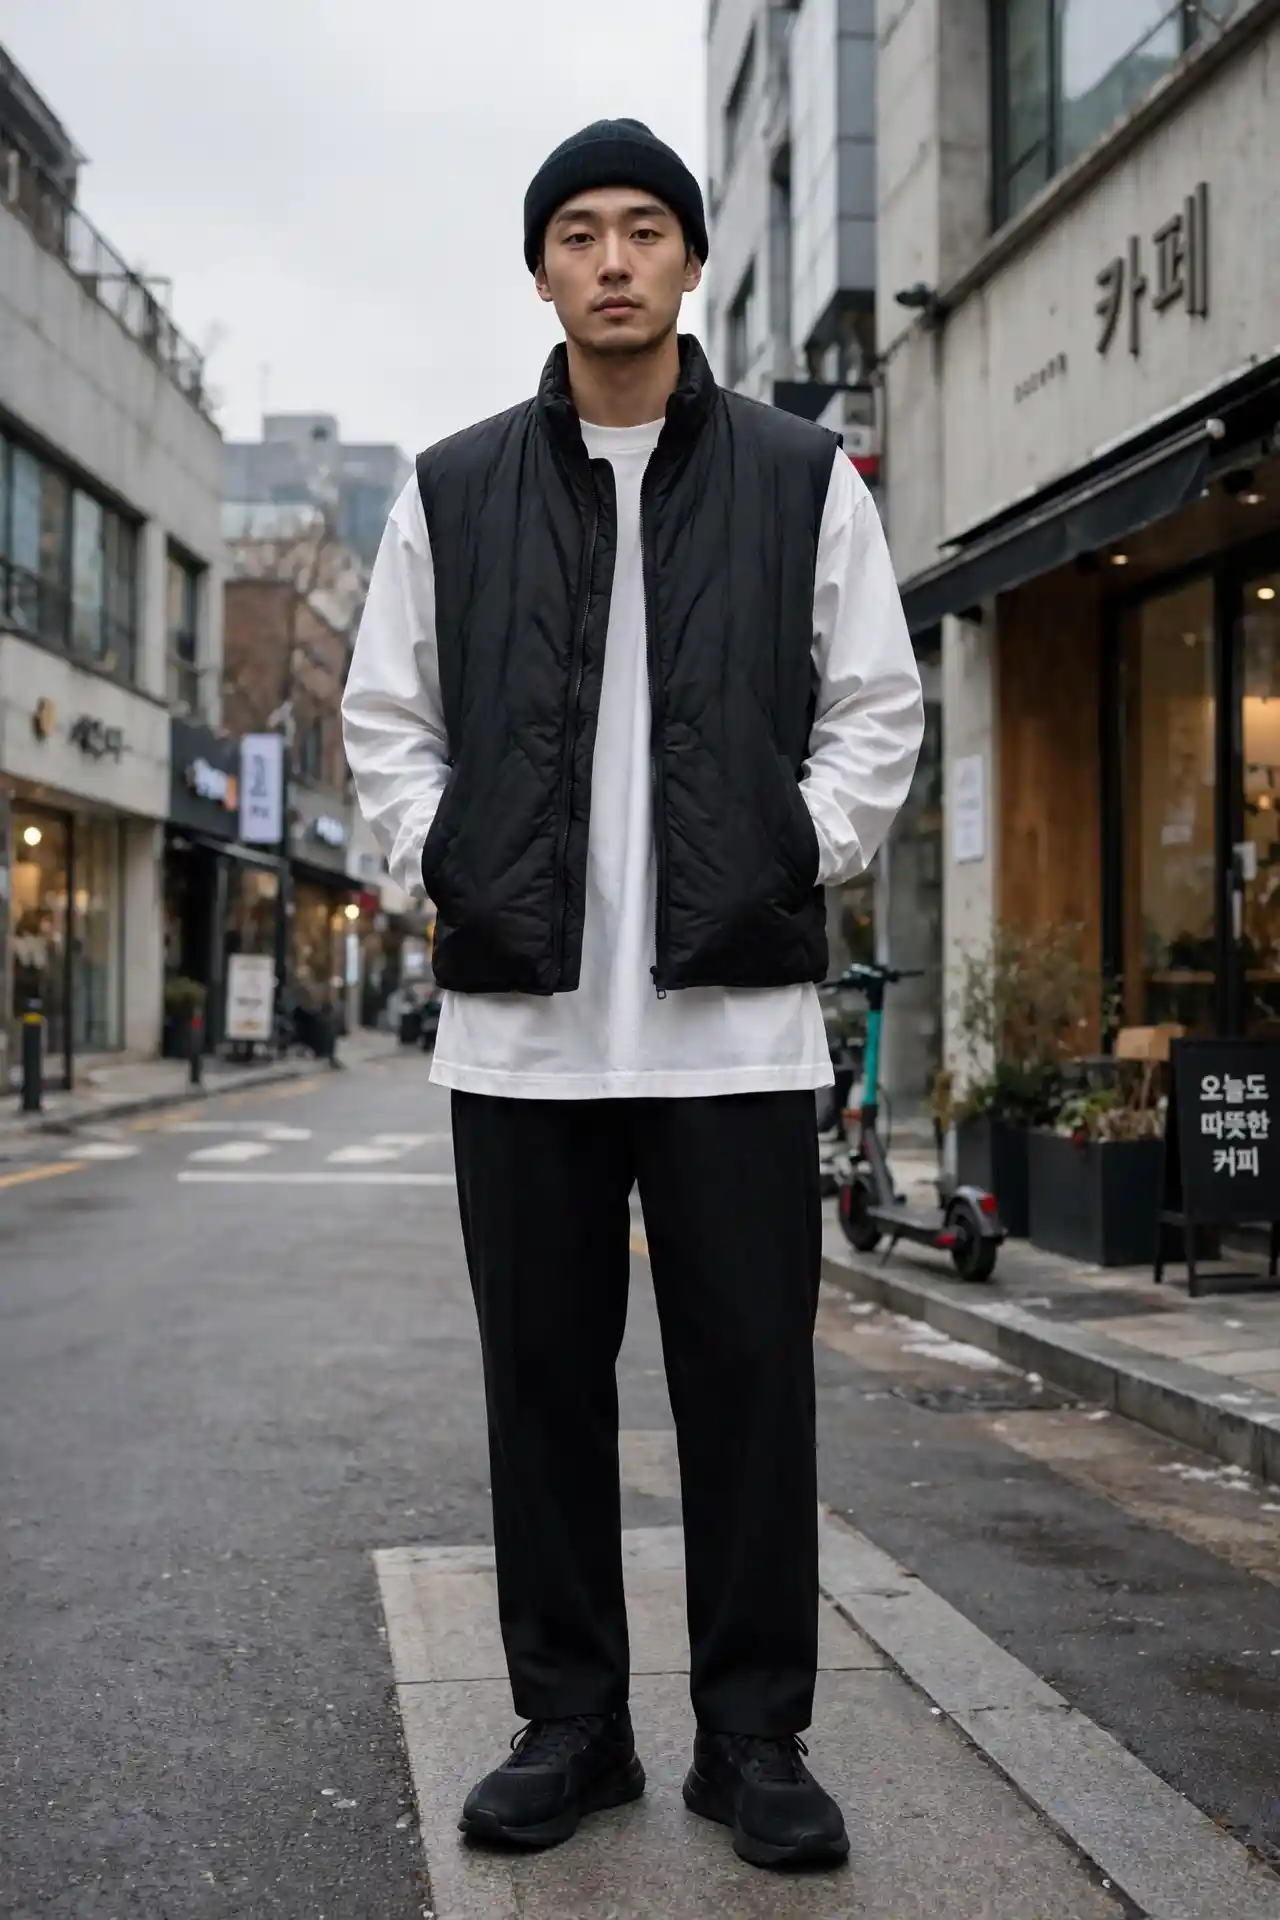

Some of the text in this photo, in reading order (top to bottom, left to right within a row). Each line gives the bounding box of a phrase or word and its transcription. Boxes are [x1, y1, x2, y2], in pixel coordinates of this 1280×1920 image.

[1096, 181, 1209, 358] 카페
[1200, 1073, 1269, 1104] 오늘도
[1201, 1110, 1271, 1140] 따뜻한
[1213, 1146, 1259, 1177] 커피
